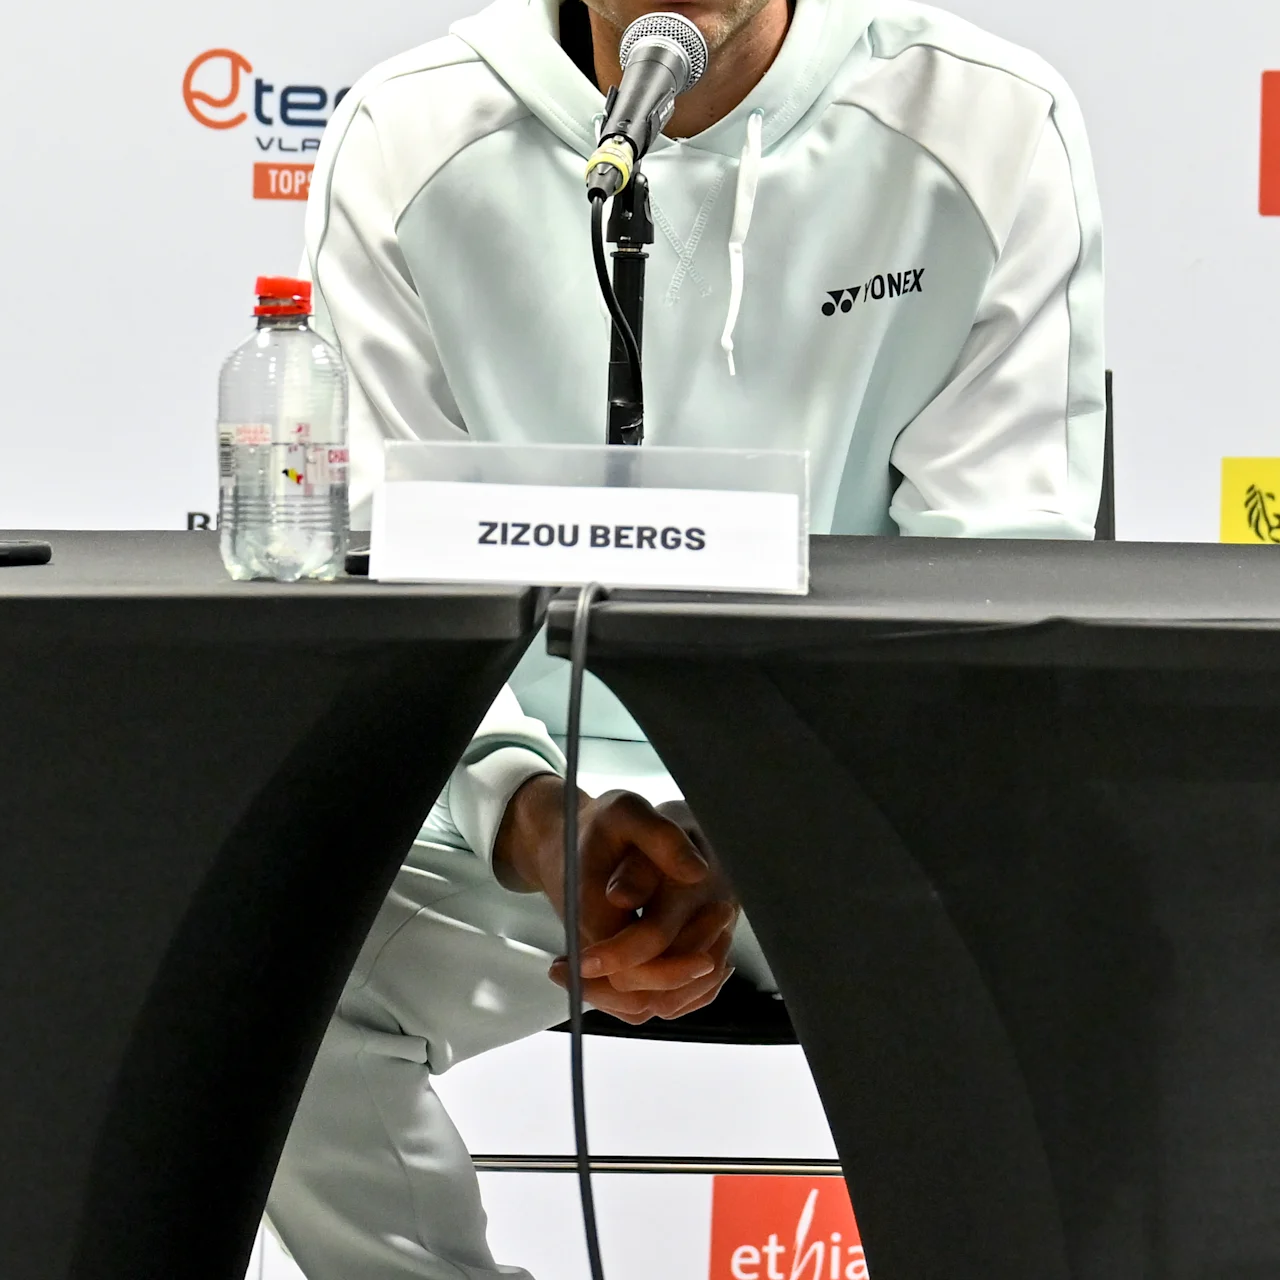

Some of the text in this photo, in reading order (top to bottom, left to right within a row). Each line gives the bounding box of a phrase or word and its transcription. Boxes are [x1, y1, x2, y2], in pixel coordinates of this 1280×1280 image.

[864, 268, 925, 303] YONEX
[477, 521, 706, 551] ZIZOU BERGS
[731, 1188, 870, 1280] ethia
